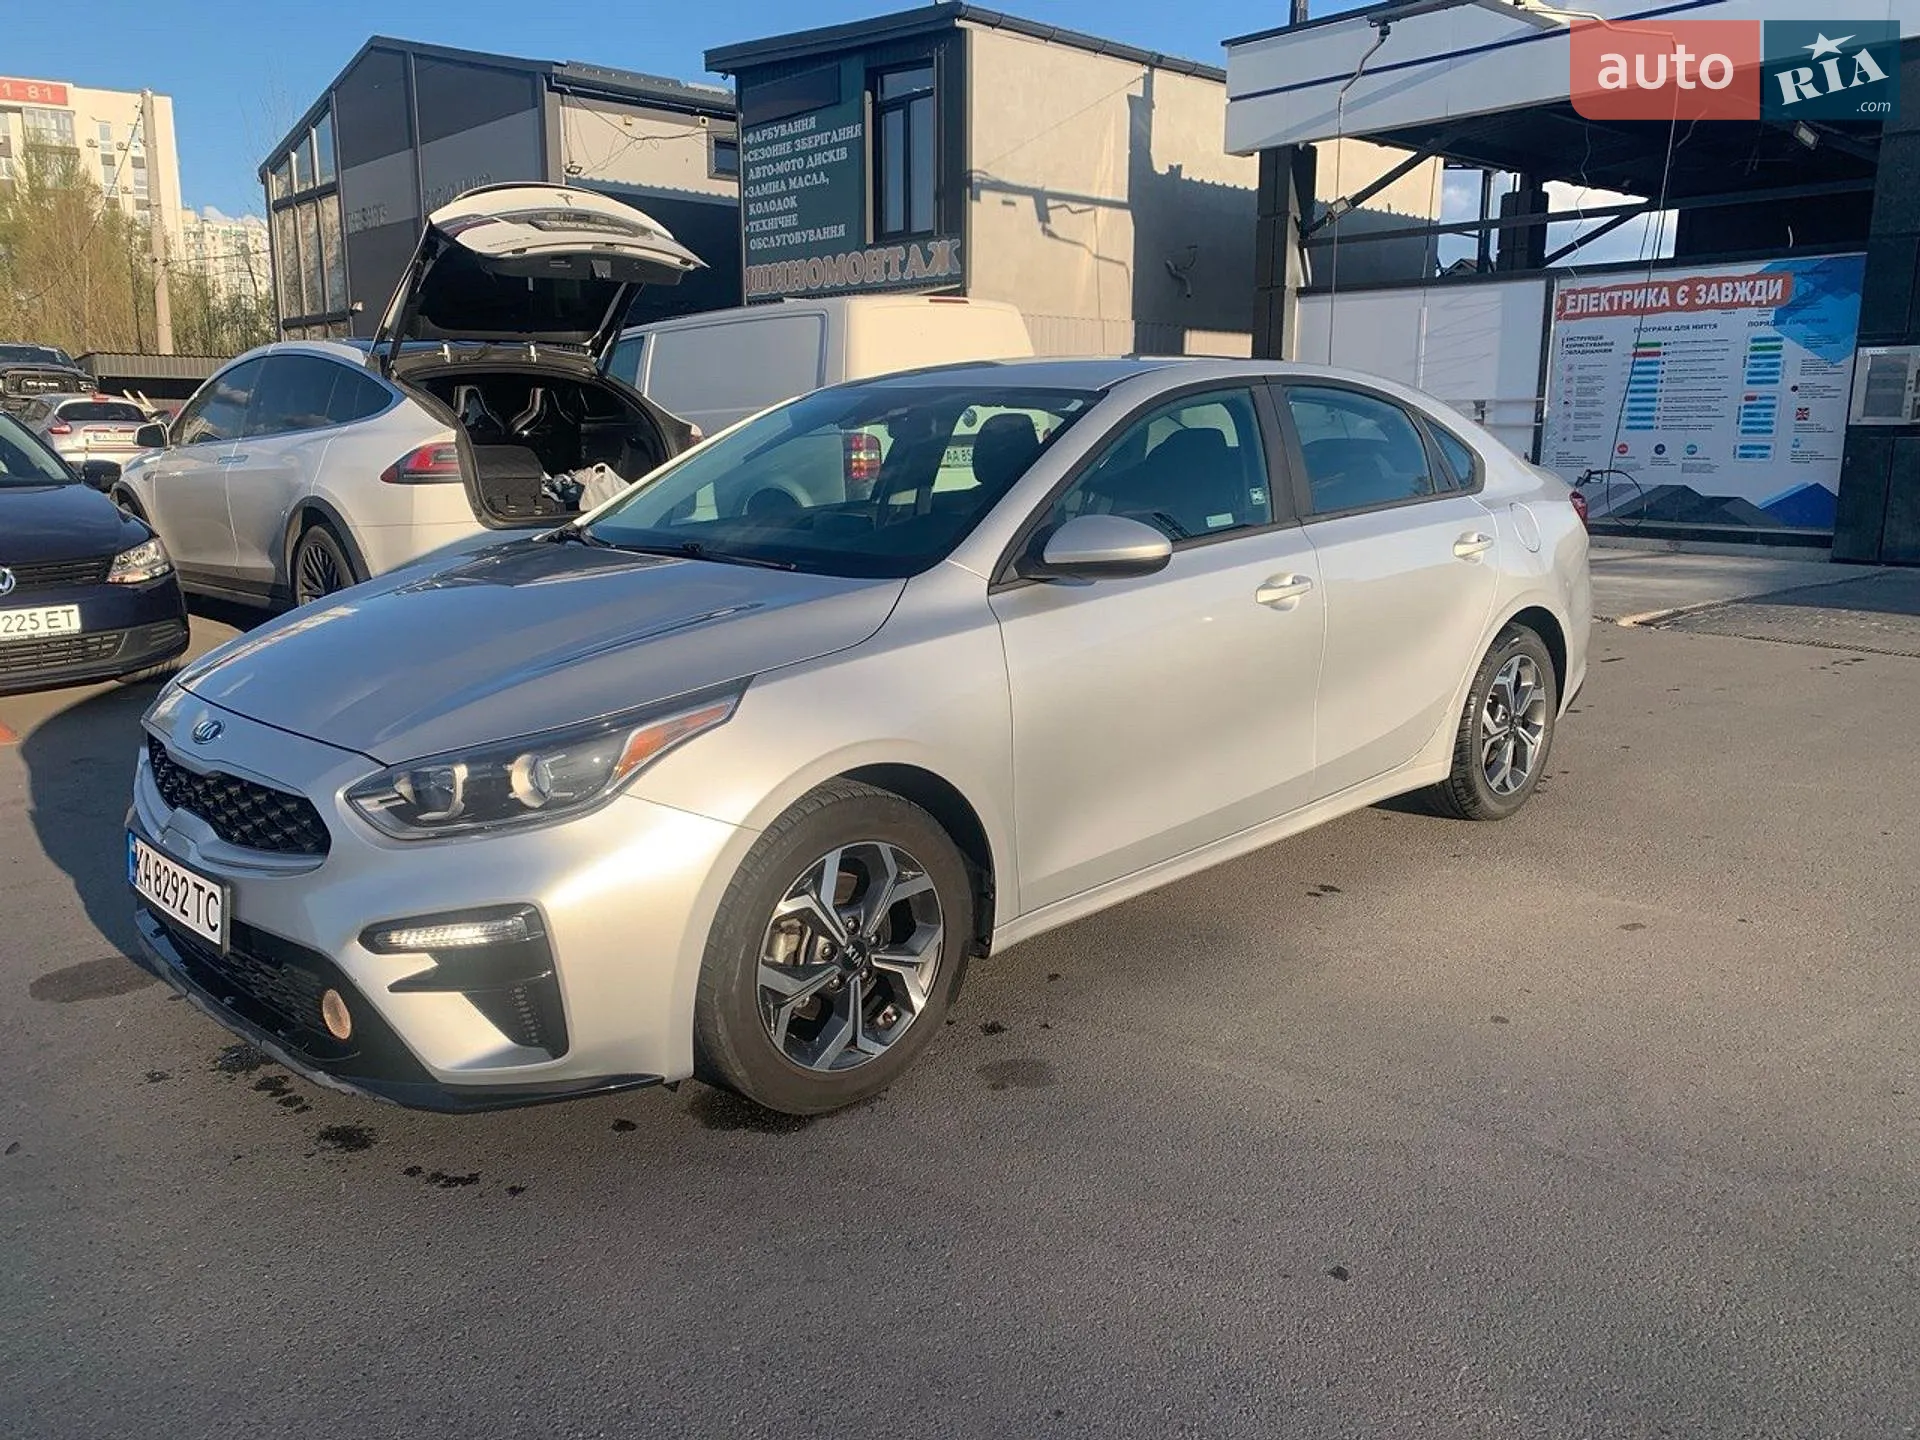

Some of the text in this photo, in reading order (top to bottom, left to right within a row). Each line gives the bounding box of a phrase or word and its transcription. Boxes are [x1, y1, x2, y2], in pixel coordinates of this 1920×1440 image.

[27, 85, 52, 100] 81
[747, 116, 816, 144] ФАРБУВАННЯ
[747, 123, 863, 162] СЕЗОННЕ ЗБЕРІГАННЯ
[748, 147, 848, 180] АВТО-МОТО ДИСКІВ
[748, 171, 829, 198] ЗАМІНА МАСЛА,
[749, 196, 798, 216] КОЛОДОК
[749, 213, 798, 233] ТЕХНІЧНЕ
[749, 224, 846, 250] ОБСЛУГОВУВАННЯ
[745, 239, 961, 296] ШИНОМОНТАЖ
[1566, 279, 1784, 313] ЕЛЕКТРИКА Є ЗАВЖДИ
[2, 609, 75, 633] 225 ET
[154, 861, 189, 918] 8292
[193, 882, 219, 932] TC
[845, 944, 862, 967] KIA
